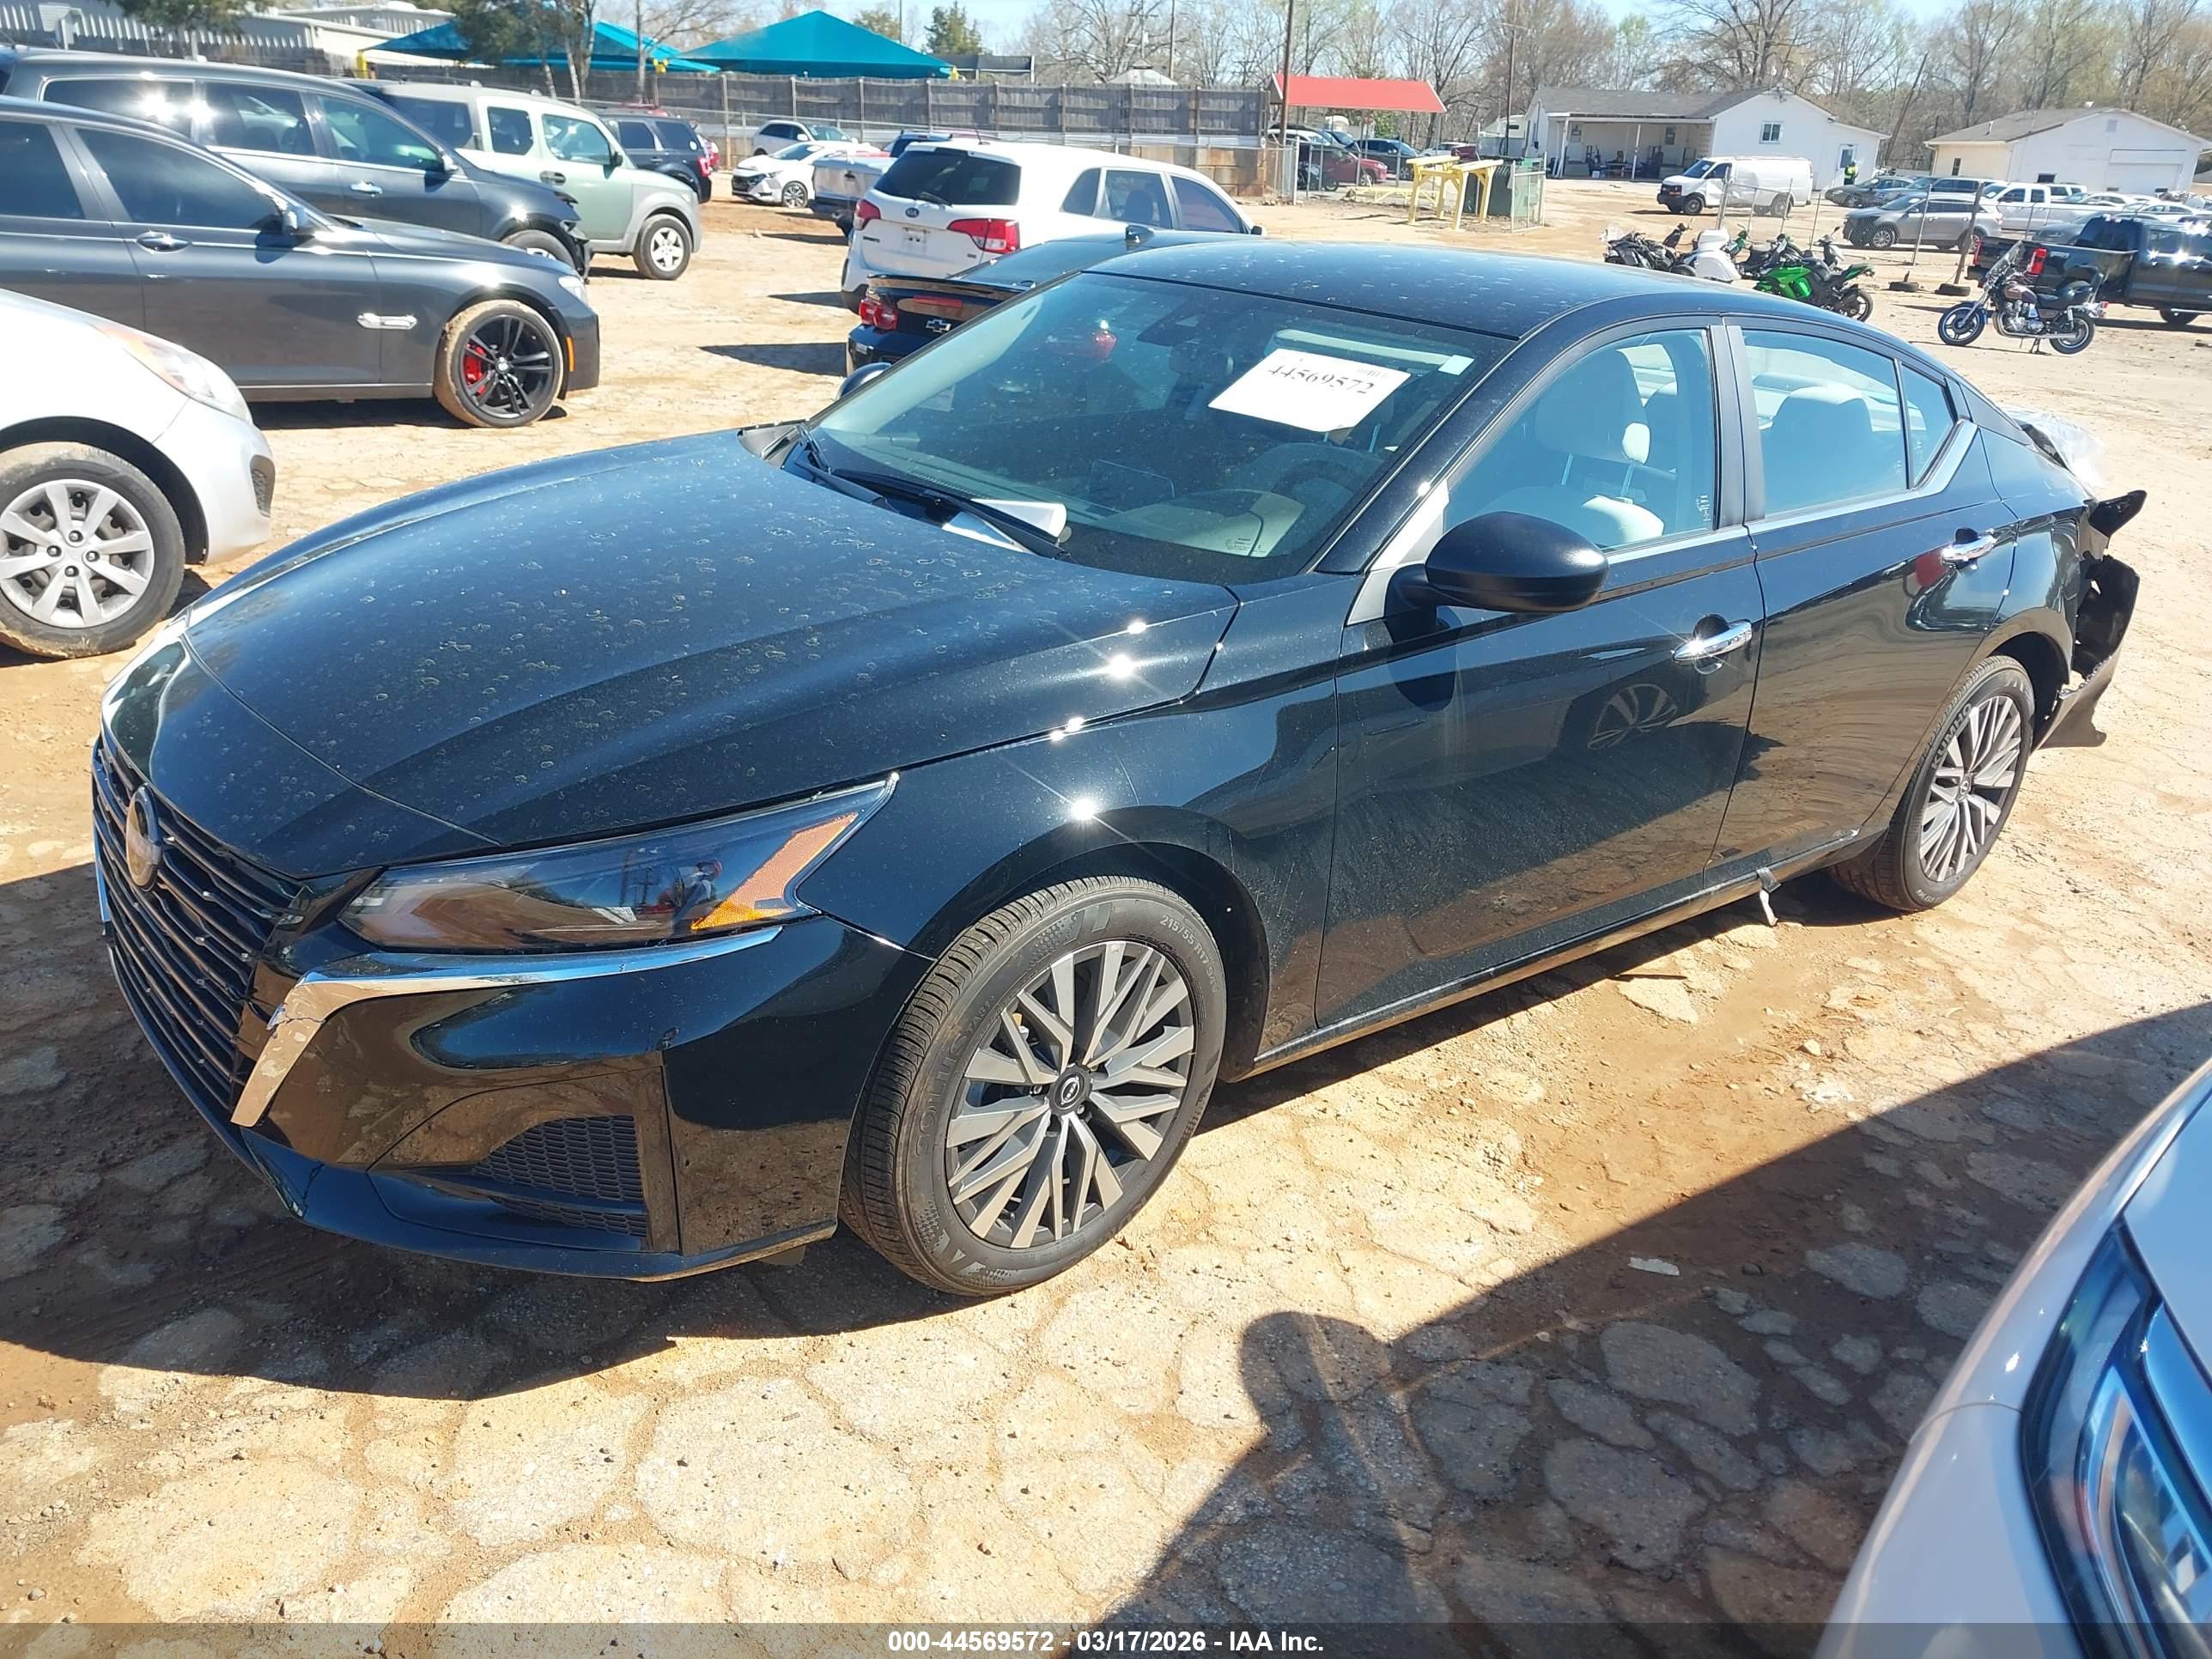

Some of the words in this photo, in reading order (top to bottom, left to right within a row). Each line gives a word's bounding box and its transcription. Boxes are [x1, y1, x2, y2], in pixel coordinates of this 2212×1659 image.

[1268, 365, 1376, 394] 44569572
[1930, 703, 1972, 770] KUMHO
[1159, 915, 1196, 945] 215/55
[1194, 942, 1210, 964] R17
[915, 1032, 968, 1157] SOLUS
